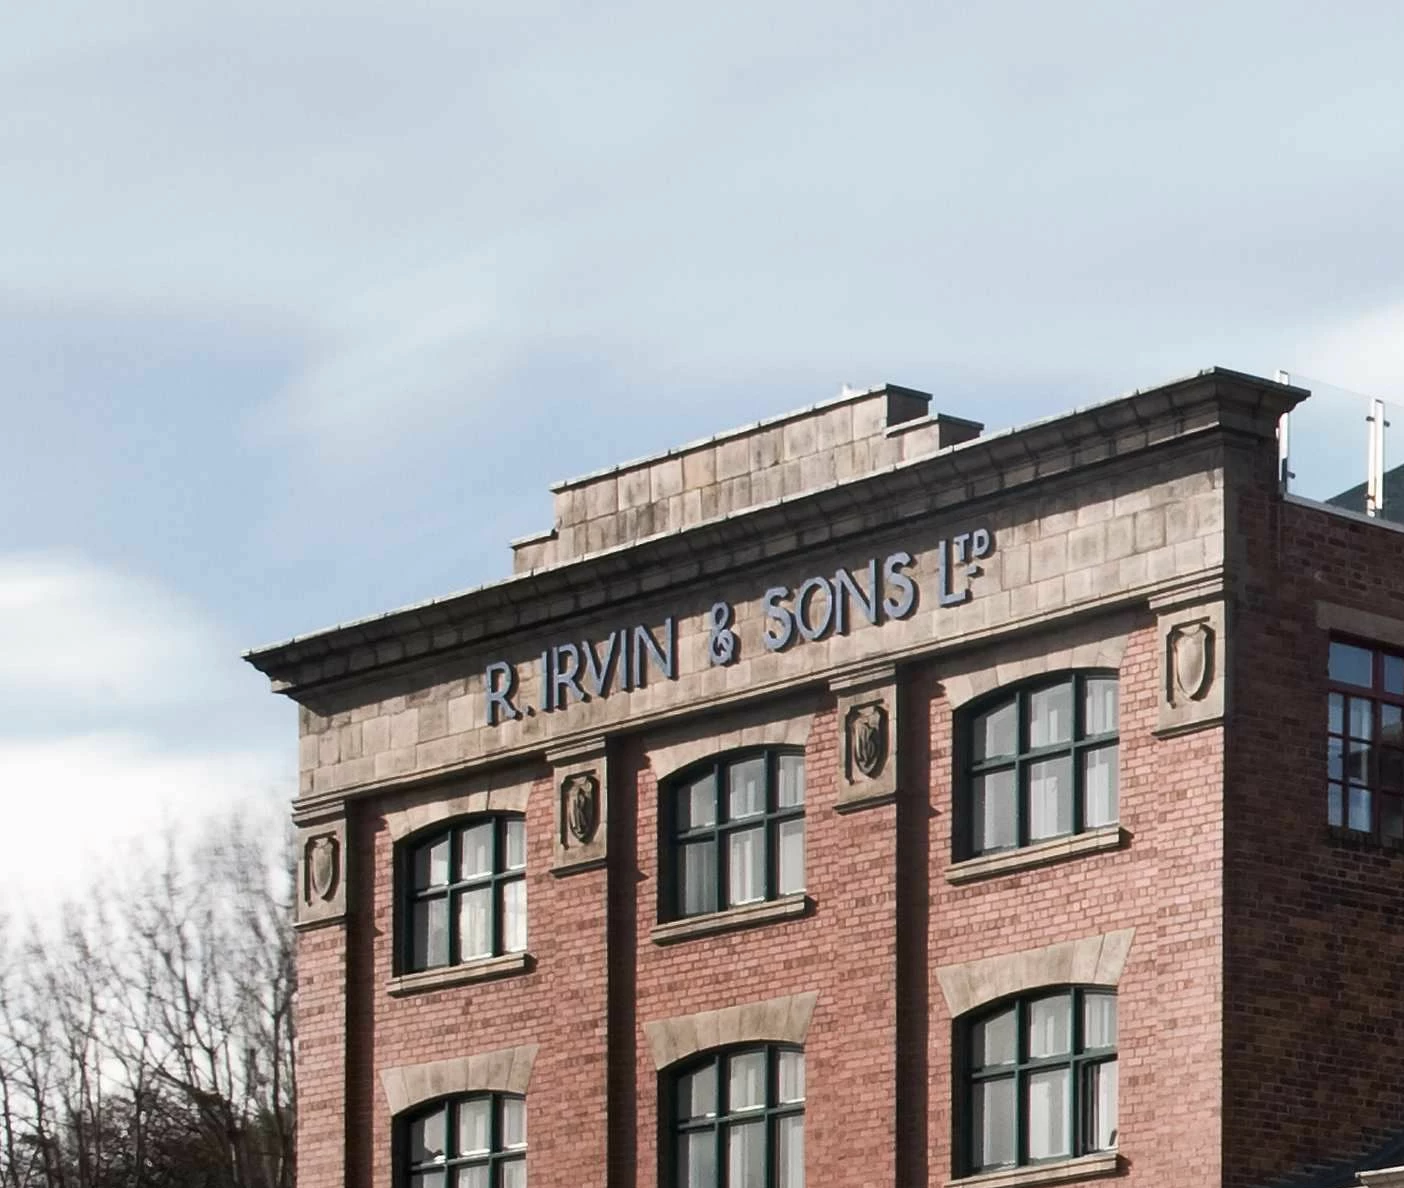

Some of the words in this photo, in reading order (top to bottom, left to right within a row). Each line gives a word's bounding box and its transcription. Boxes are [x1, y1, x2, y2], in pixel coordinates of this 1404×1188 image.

[541, 617, 676, 711] IRVIN
[711, 601, 736, 666] &
[763, 551, 917, 651] SONS
